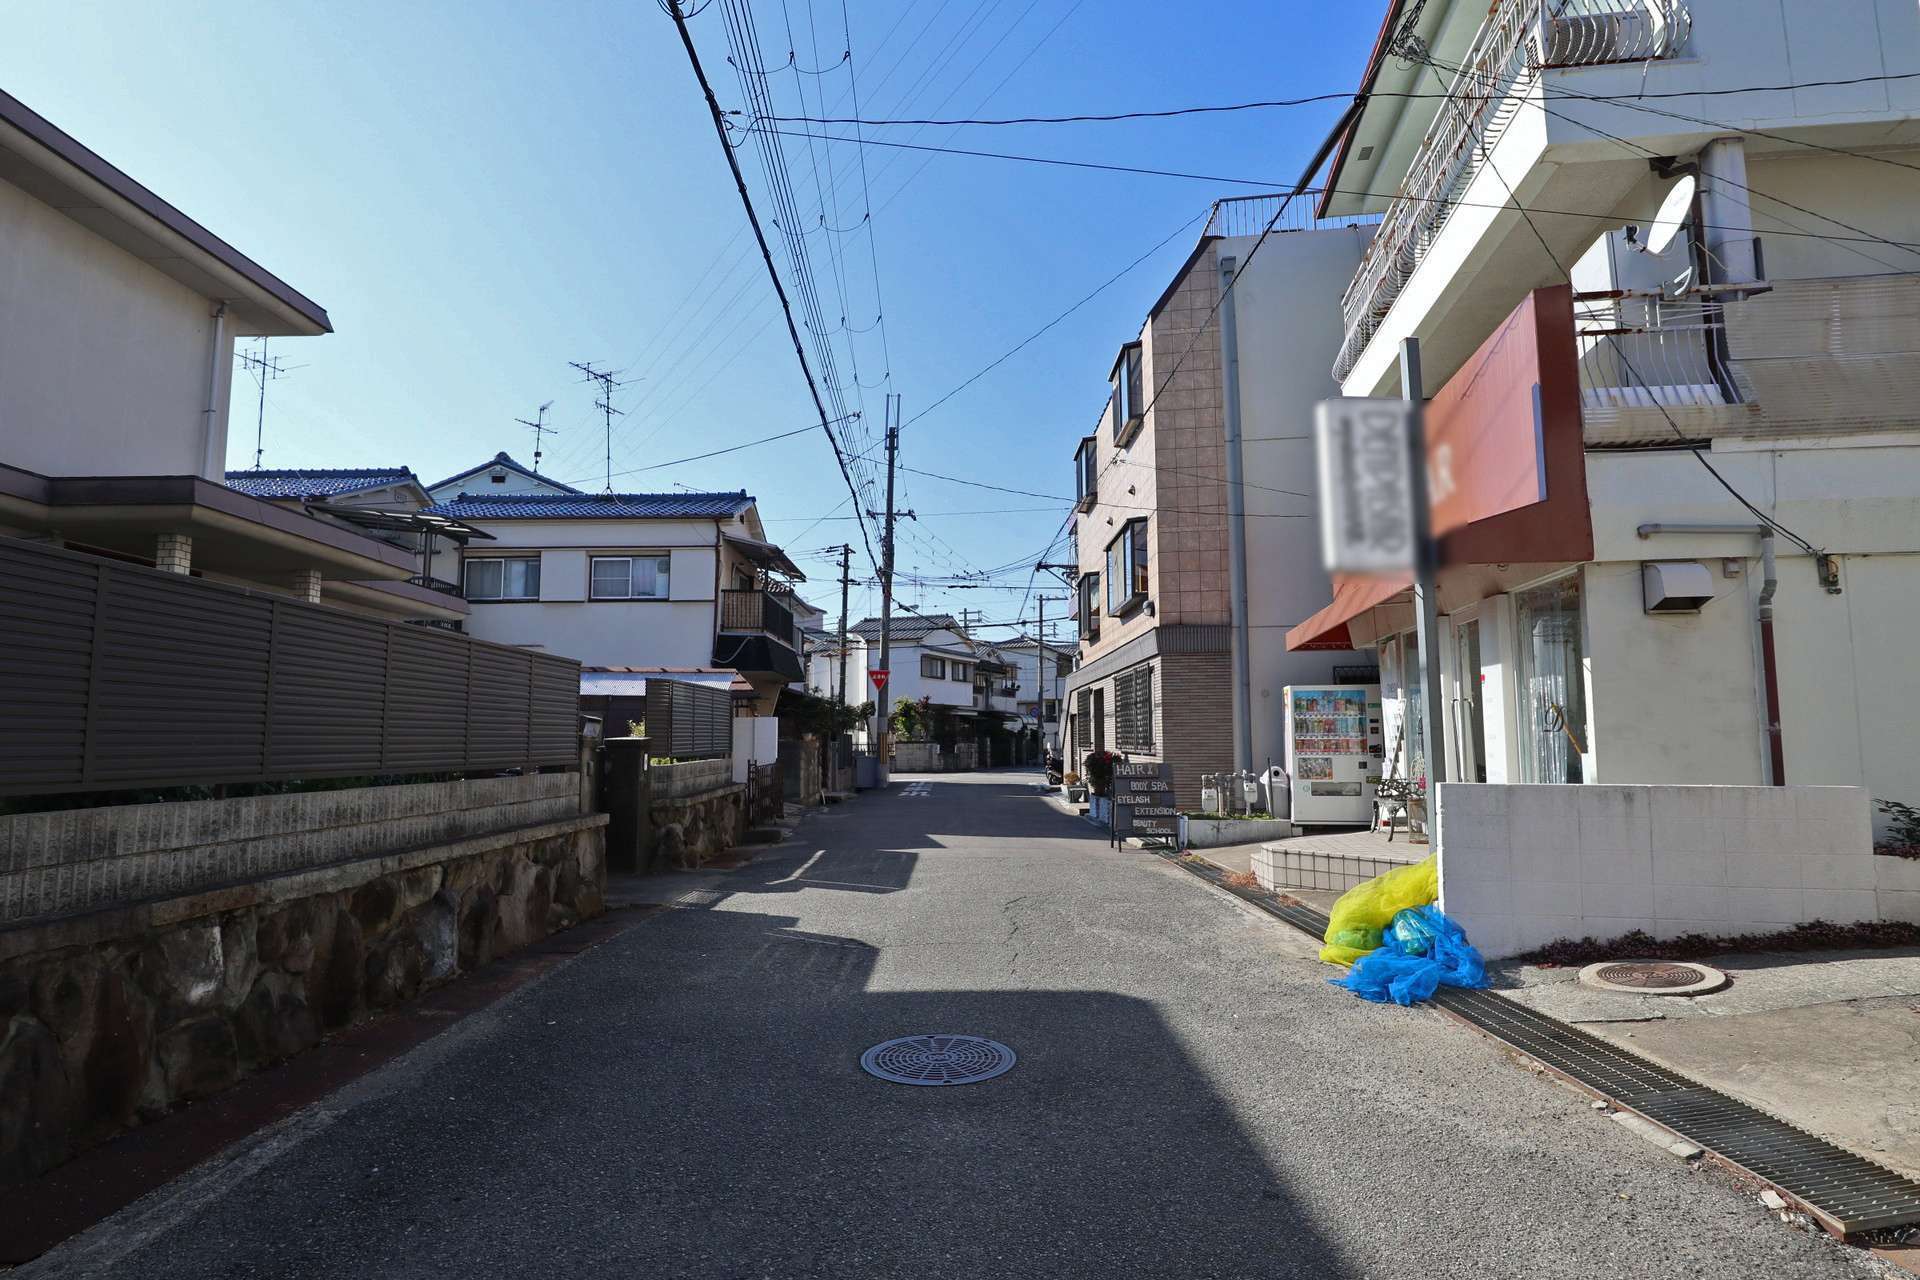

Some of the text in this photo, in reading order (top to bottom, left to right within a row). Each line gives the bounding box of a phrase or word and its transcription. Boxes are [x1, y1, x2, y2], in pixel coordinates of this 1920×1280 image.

[1116, 764, 1145, 775] HAIR
[1130, 781, 1168, 791] BODY SPA
[1117, 795, 1151, 804] EYELASH
[1135, 807, 1176, 816] EXTENSION
